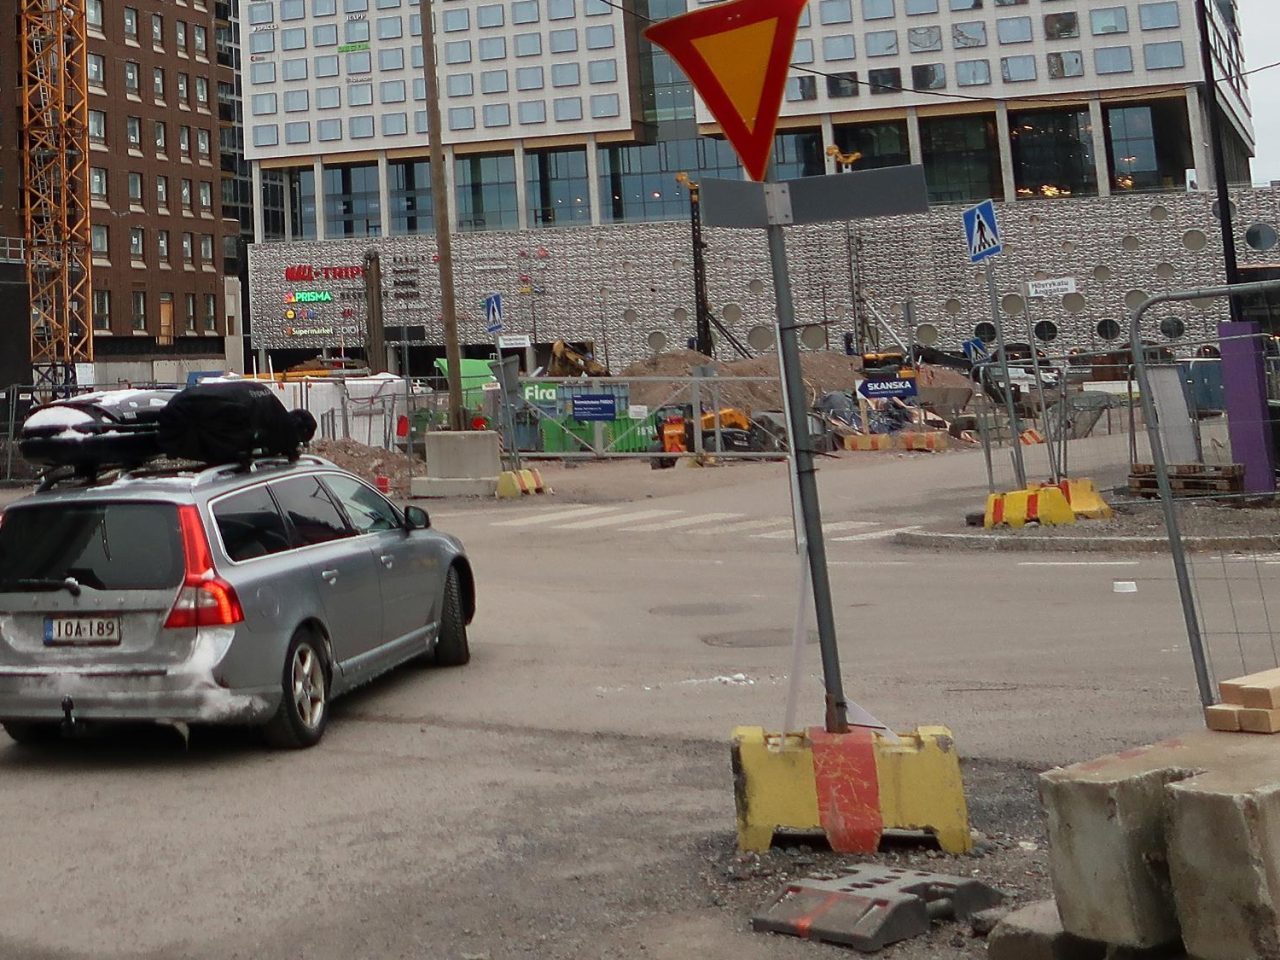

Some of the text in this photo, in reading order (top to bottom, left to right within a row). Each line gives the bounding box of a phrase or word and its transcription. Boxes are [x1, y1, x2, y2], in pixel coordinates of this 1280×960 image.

[295, 291, 332, 303] PRISMA
[867, 381, 912, 391] SKANSKA
[524, 385, 557, 401] Fira
